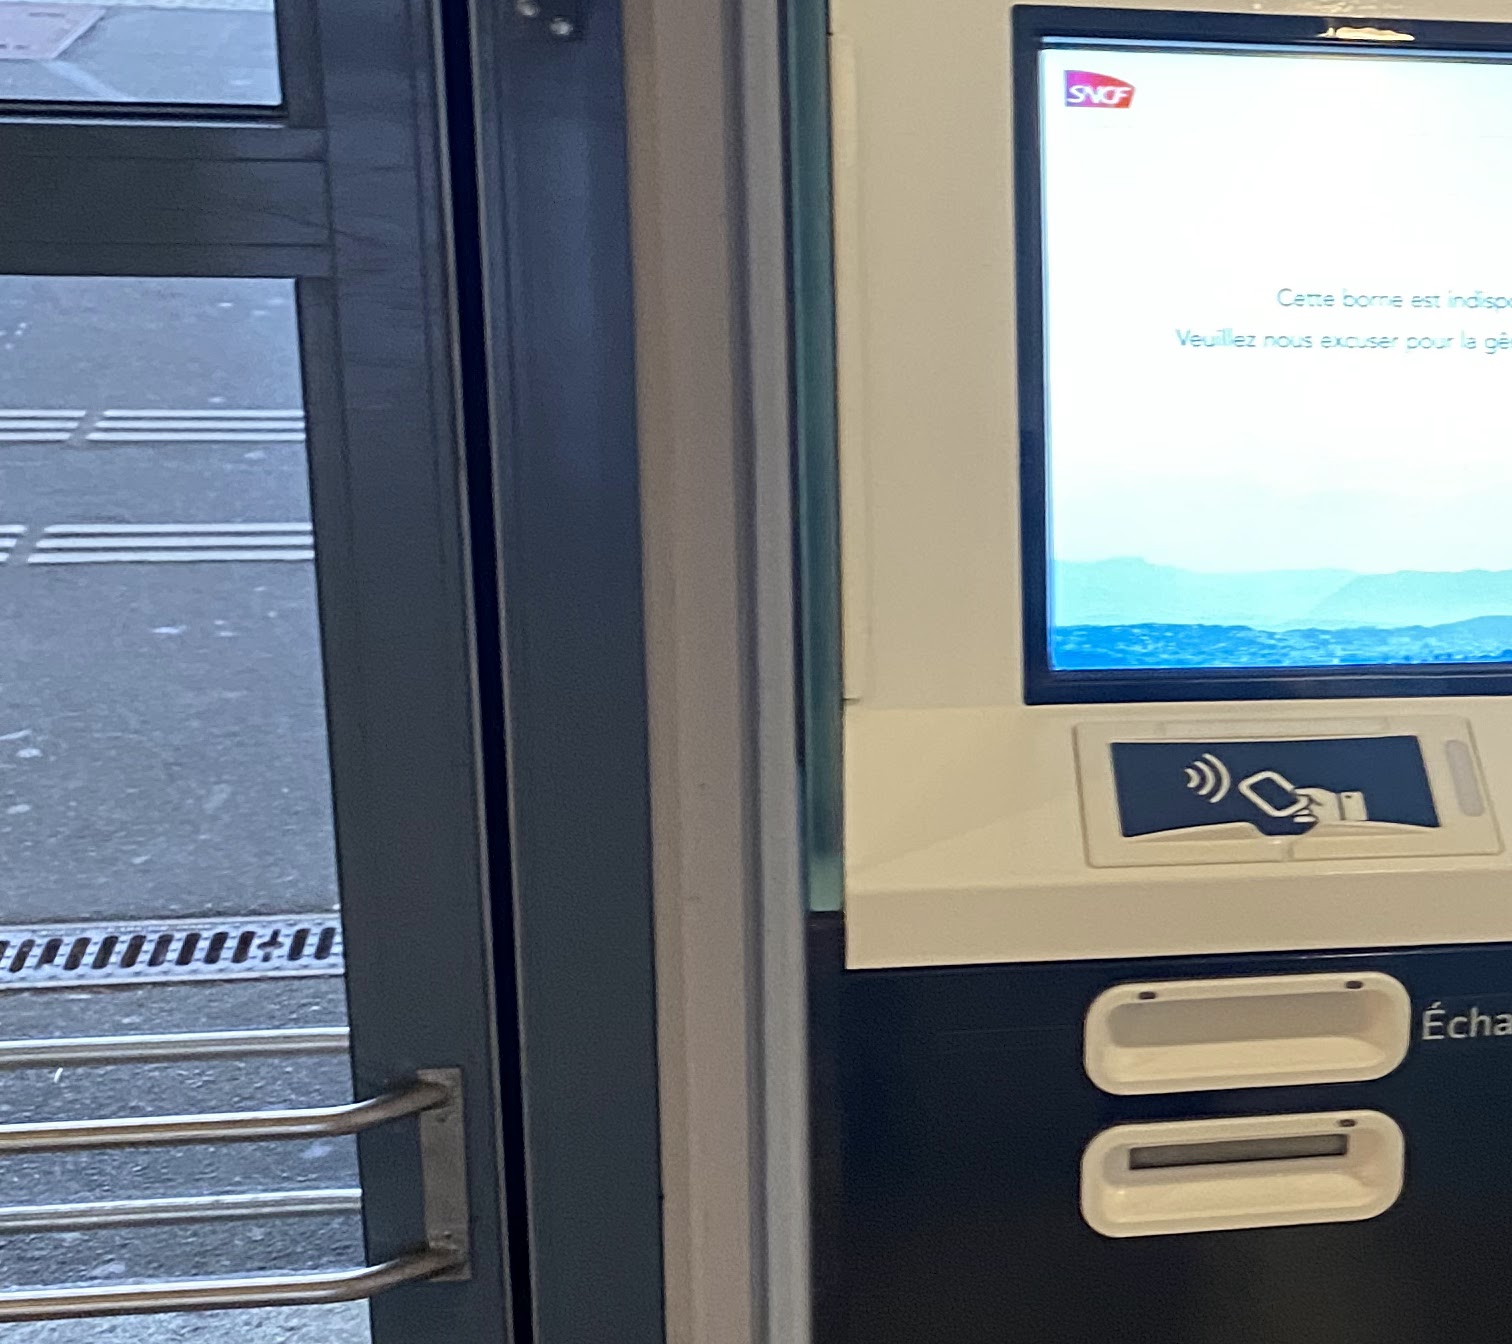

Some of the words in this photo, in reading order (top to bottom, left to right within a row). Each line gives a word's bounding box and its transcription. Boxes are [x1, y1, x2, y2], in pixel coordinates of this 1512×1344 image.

[1066, 84, 1133, 105] SNCF
[1276, 288, 1336, 307] Cette
[1342, 289, 1403, 308] borne
[1410, 293, 1441, 309] est
[1175, 327, 1256, 348] Veuillez
[1263, 334, 1313, 349] nous
[1320, 335, 1398, 349] excuser
[1405, 336, 1455, 353] pour
[1460, 330, 1477, 350] la
